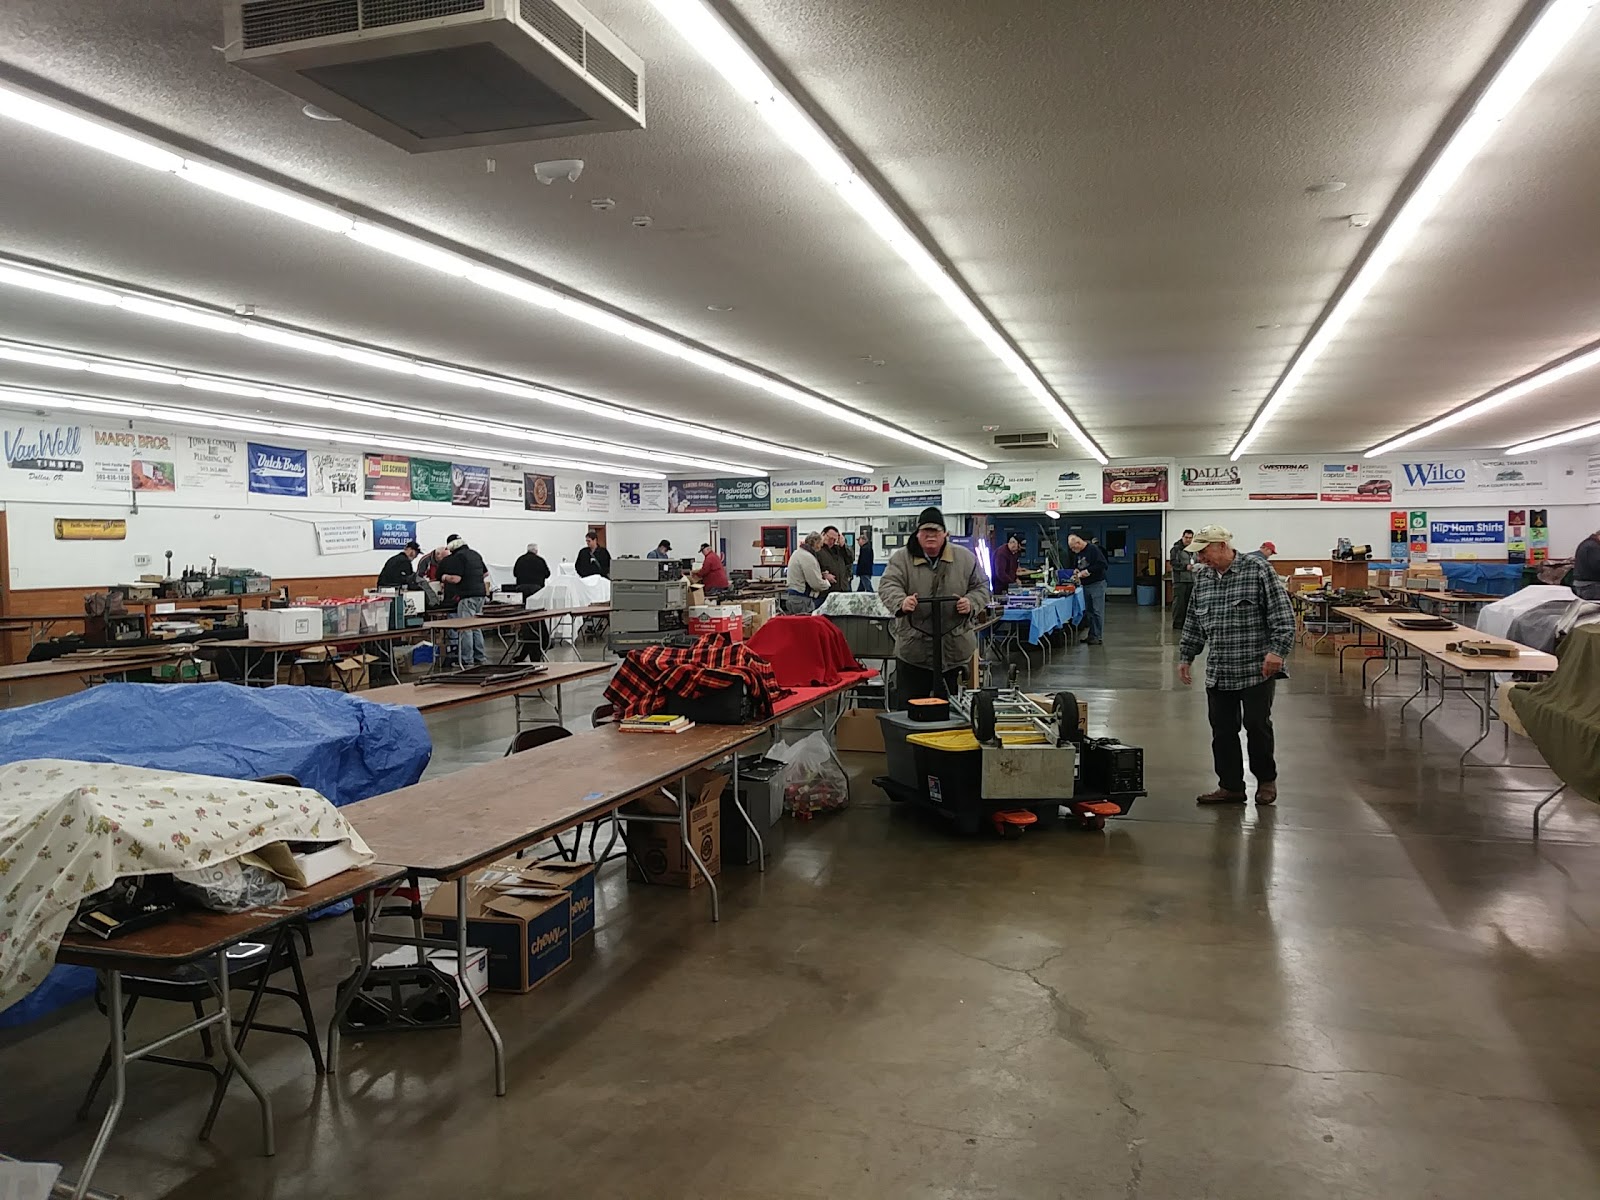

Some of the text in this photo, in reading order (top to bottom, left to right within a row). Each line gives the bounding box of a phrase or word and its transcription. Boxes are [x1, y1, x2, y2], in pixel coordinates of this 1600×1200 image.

[95, 431, 136, 448] MARR
[36, 460, 76, 468] TIMBER
[257, 452, 282, 469] Dutch
[1186, 466, 1239, 481] DALLAS
[1402, 463, 1466, 486] Wilco
[799, 480, 824, 488] Roofing
[1432, 522, 1504, 534] Hip Ham Shirts
